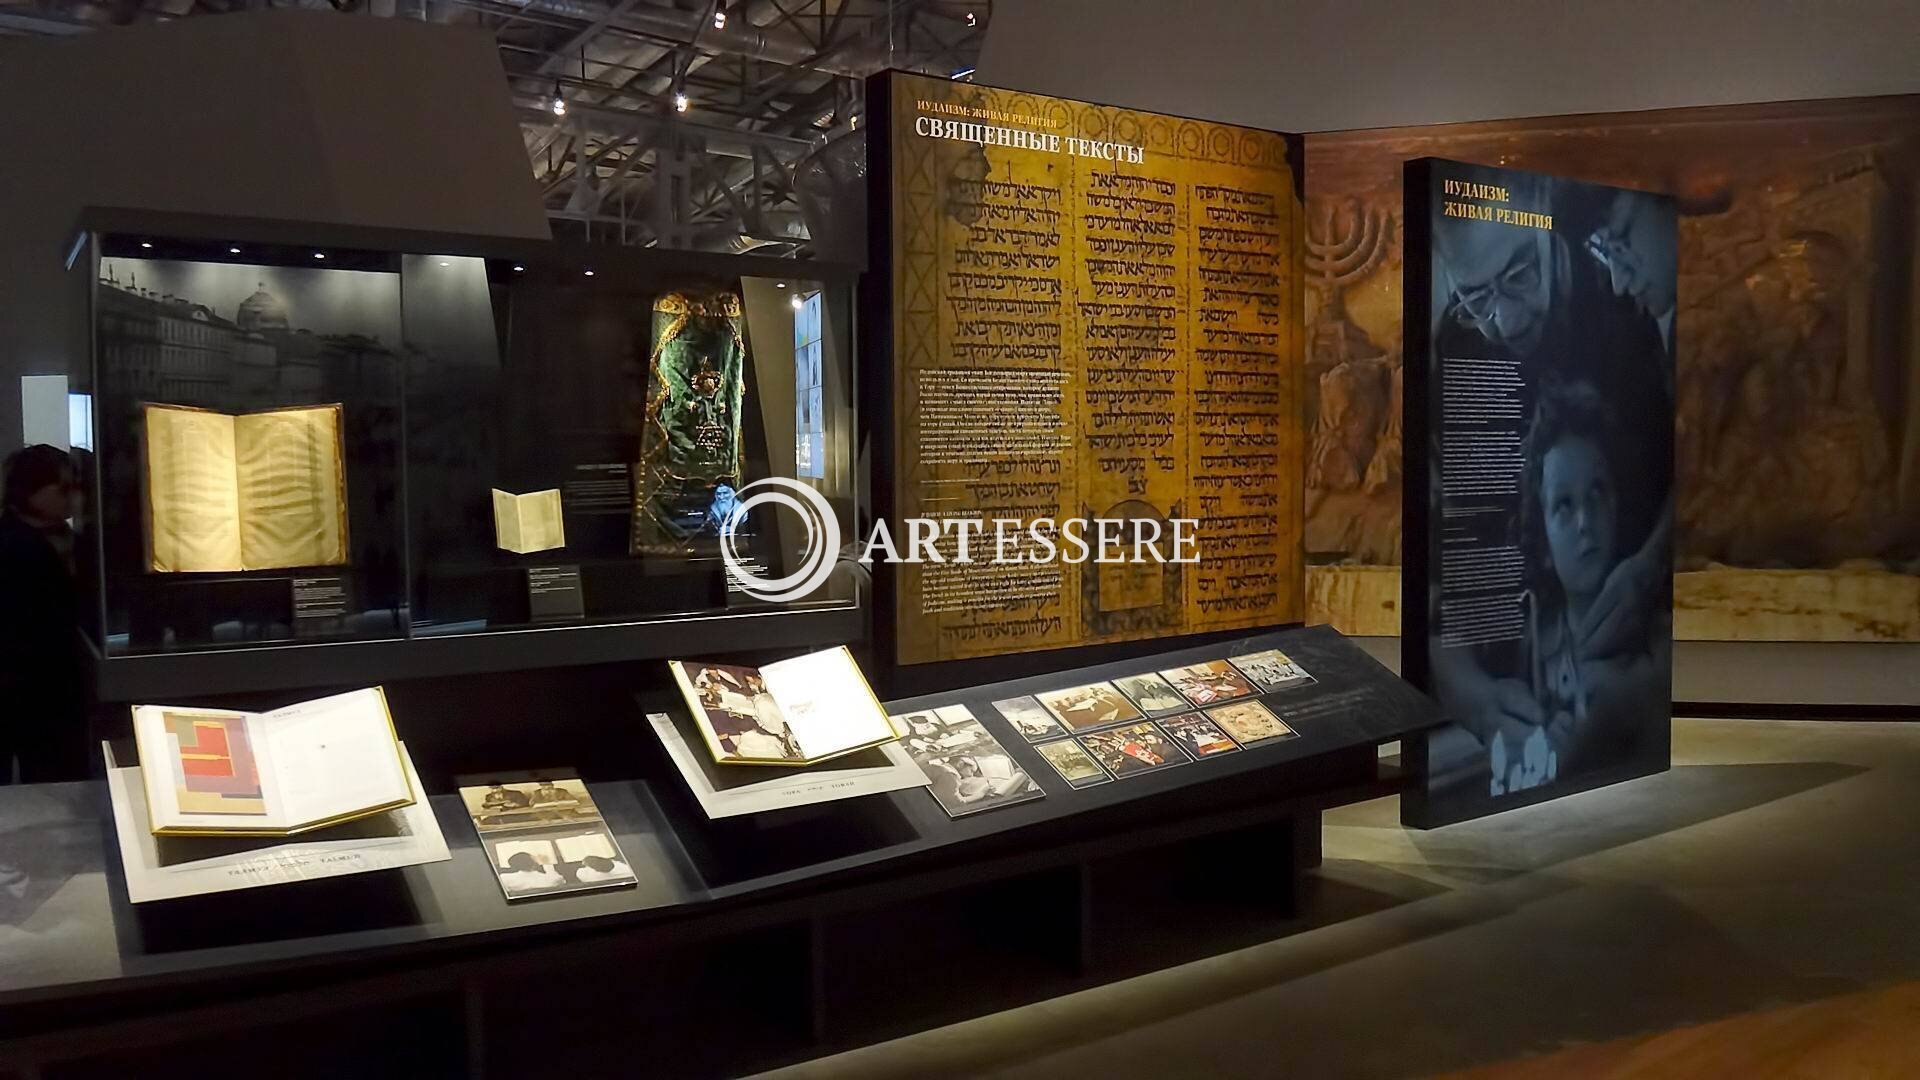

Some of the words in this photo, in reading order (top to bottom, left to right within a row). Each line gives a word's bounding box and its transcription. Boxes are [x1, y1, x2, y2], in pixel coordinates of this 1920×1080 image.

[917, 99, 971, 118] ИУДАИЗМ:
[972, 108, 1010, 123] ЖИВАЯ
[1013, 113, 1058, 129] РЕЛИГИЯ
[915, 116, 1060, 154] СВЯЩЕННЫЕ
[1065, 138, 1145, 165] ТЕКСТЫ
[1444, 179, 1510, 203] ИУДАИЗМ:
[1444, 202, 1494, 221] ЖИВАЯ
[1497, 210, 1553, 230] РЕЛИГИЯ
